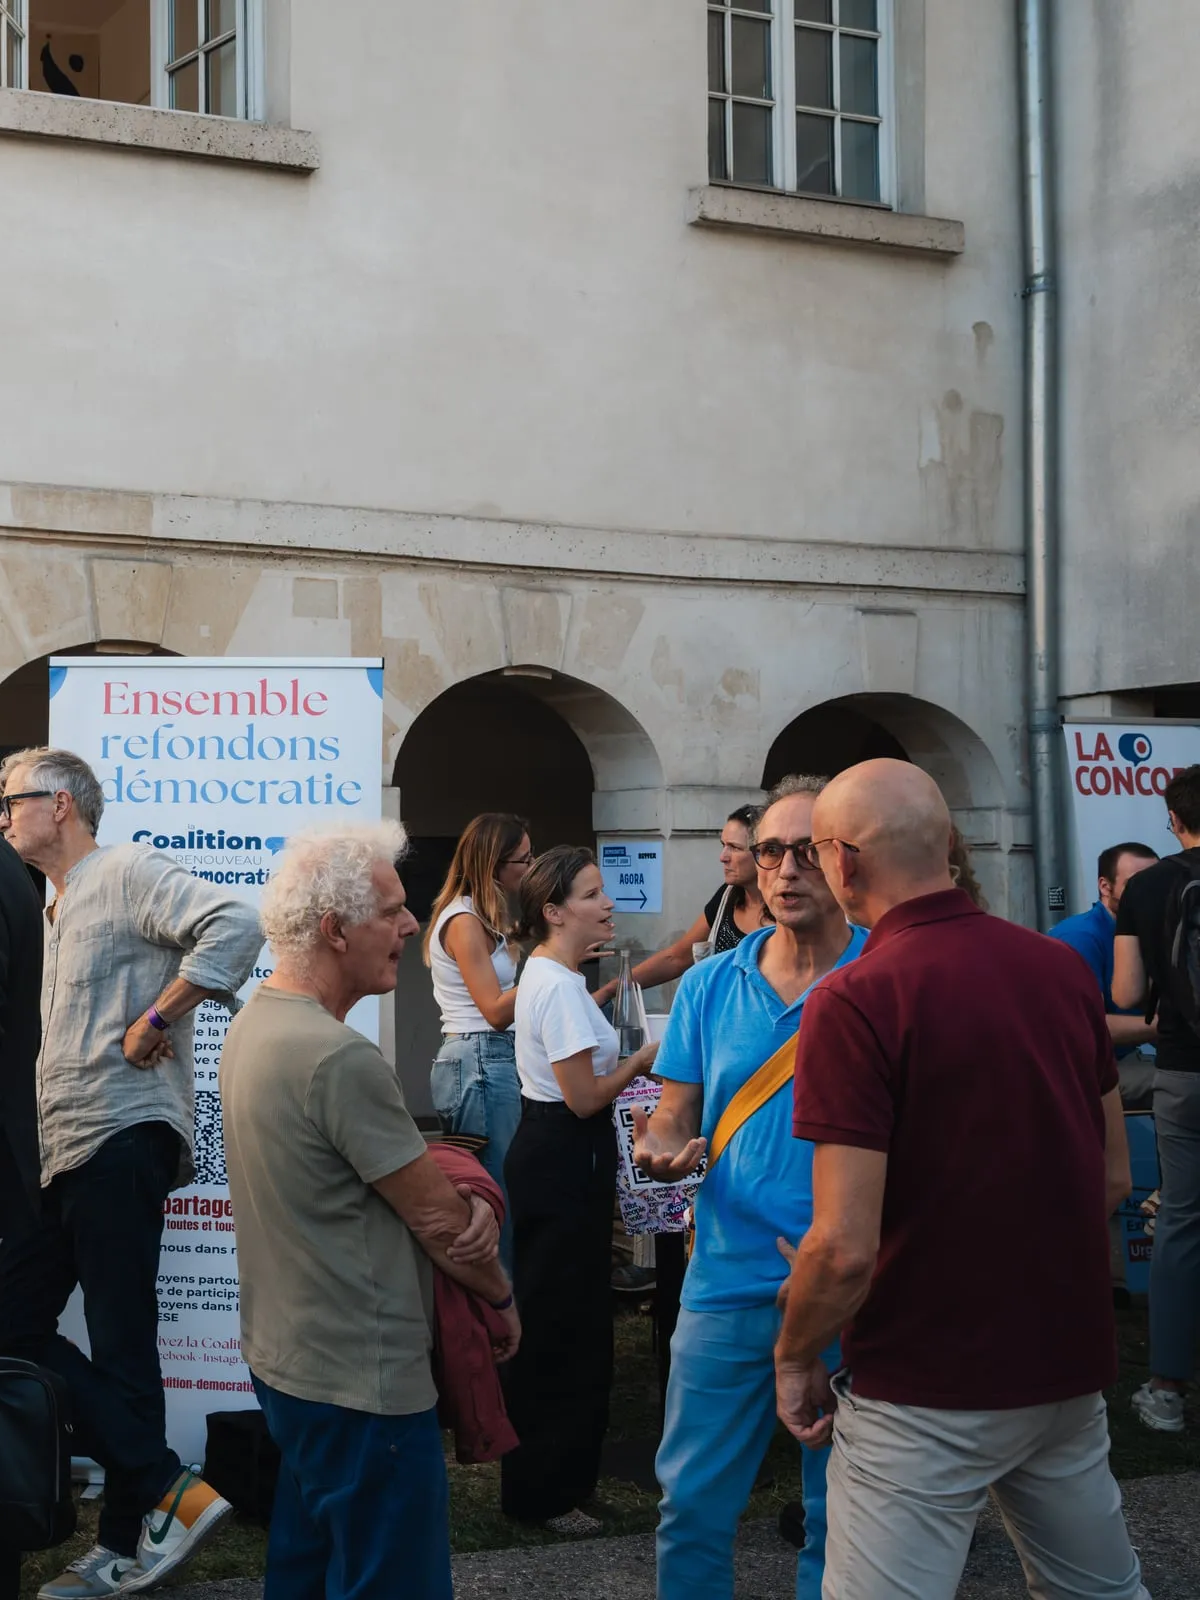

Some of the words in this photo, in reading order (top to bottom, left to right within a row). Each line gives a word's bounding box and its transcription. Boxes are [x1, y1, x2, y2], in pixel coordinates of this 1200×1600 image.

[103, 678, 328, 716] Ensemble
[100, 723, 340, 761] refondons
[1075, 732, 1114, 761] LA
[101, 765, 362, 805] démocratie
[132, 829, 262, 851] Coalition
[175, 854, 263, 866] RENOUVEAU
[190, 866, 270, 886] émocrati
[619, 872, 645, 885] AGORA
[202, 1000, 226, 1011] sig
[208, 1027, 220, 1037] la
[166, 1219, 199, 1231] toutes
[202, 1220, 212, 1231] et
[195, 1243, 227, 1255] dans
[167, 1286, 183, 1296] de
[201, 1301, 232, 1312] dans
[186, 1335, 198, 1348] la
